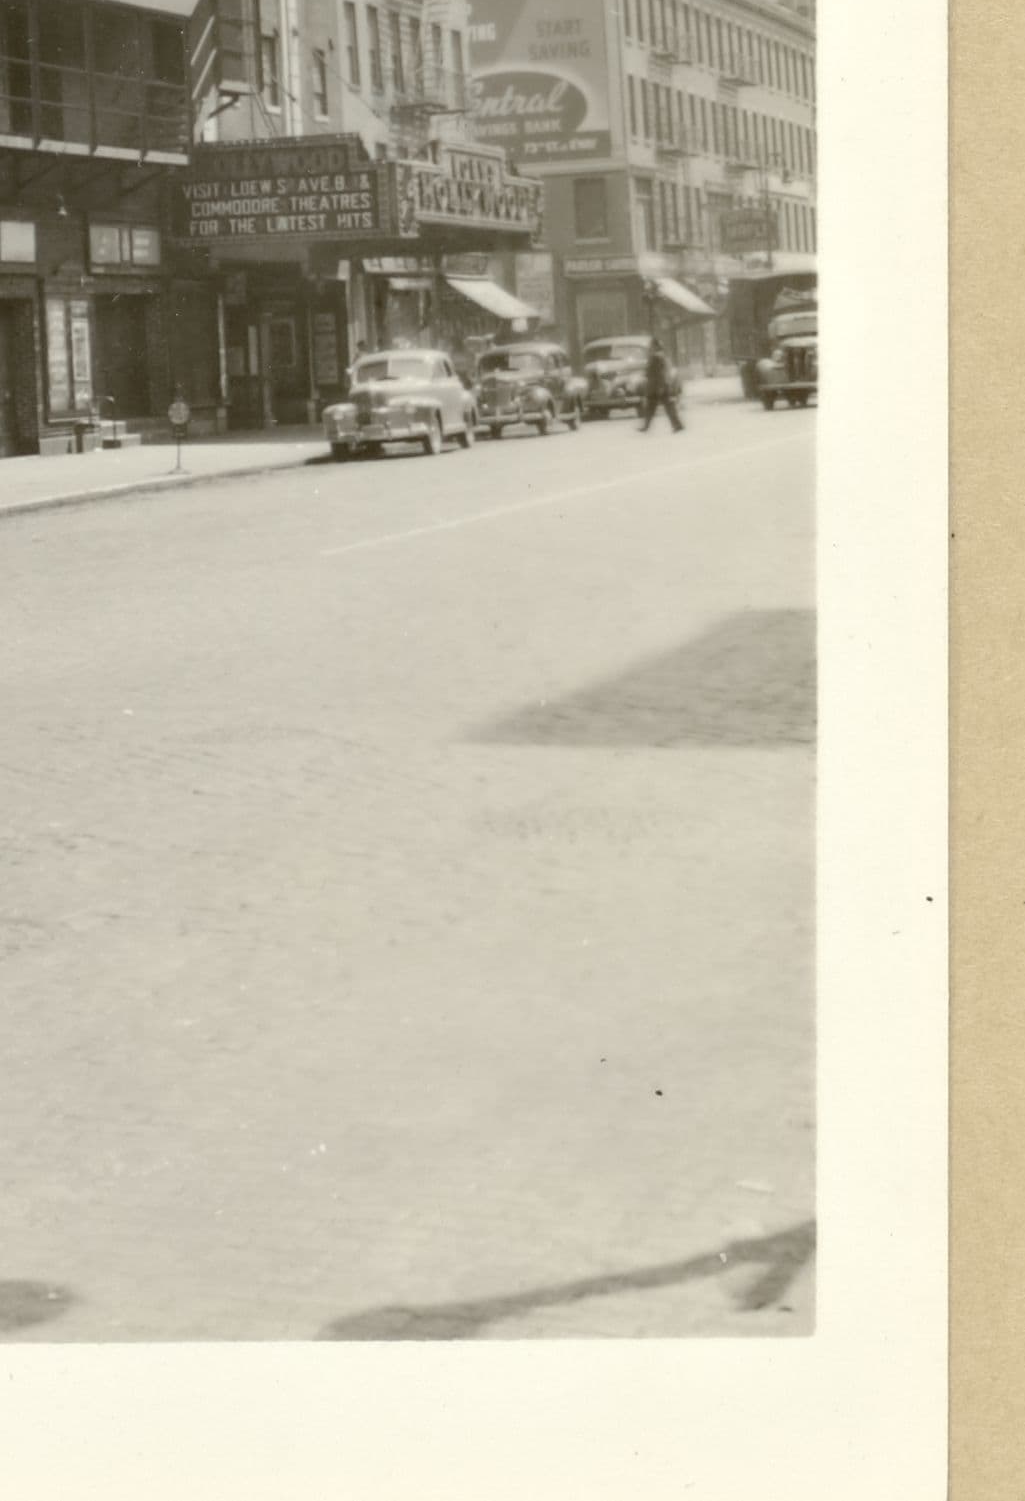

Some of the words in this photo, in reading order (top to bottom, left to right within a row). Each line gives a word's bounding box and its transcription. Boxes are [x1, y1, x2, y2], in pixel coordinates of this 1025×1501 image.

[536, 18, 583, 37] START
[529, 39, 592, 60] SAVING
[182, 182, 219, 198] VISIT
[191, 198, 280, 217] COMMODORE
[289, 193, 371, 212] THEATRES
[190, 219, 219, 236] FOR
[229, 217, 257, 234] THE
[266, 214, 327, 232] LATEST
[337, 212, 373, 228] HITS
